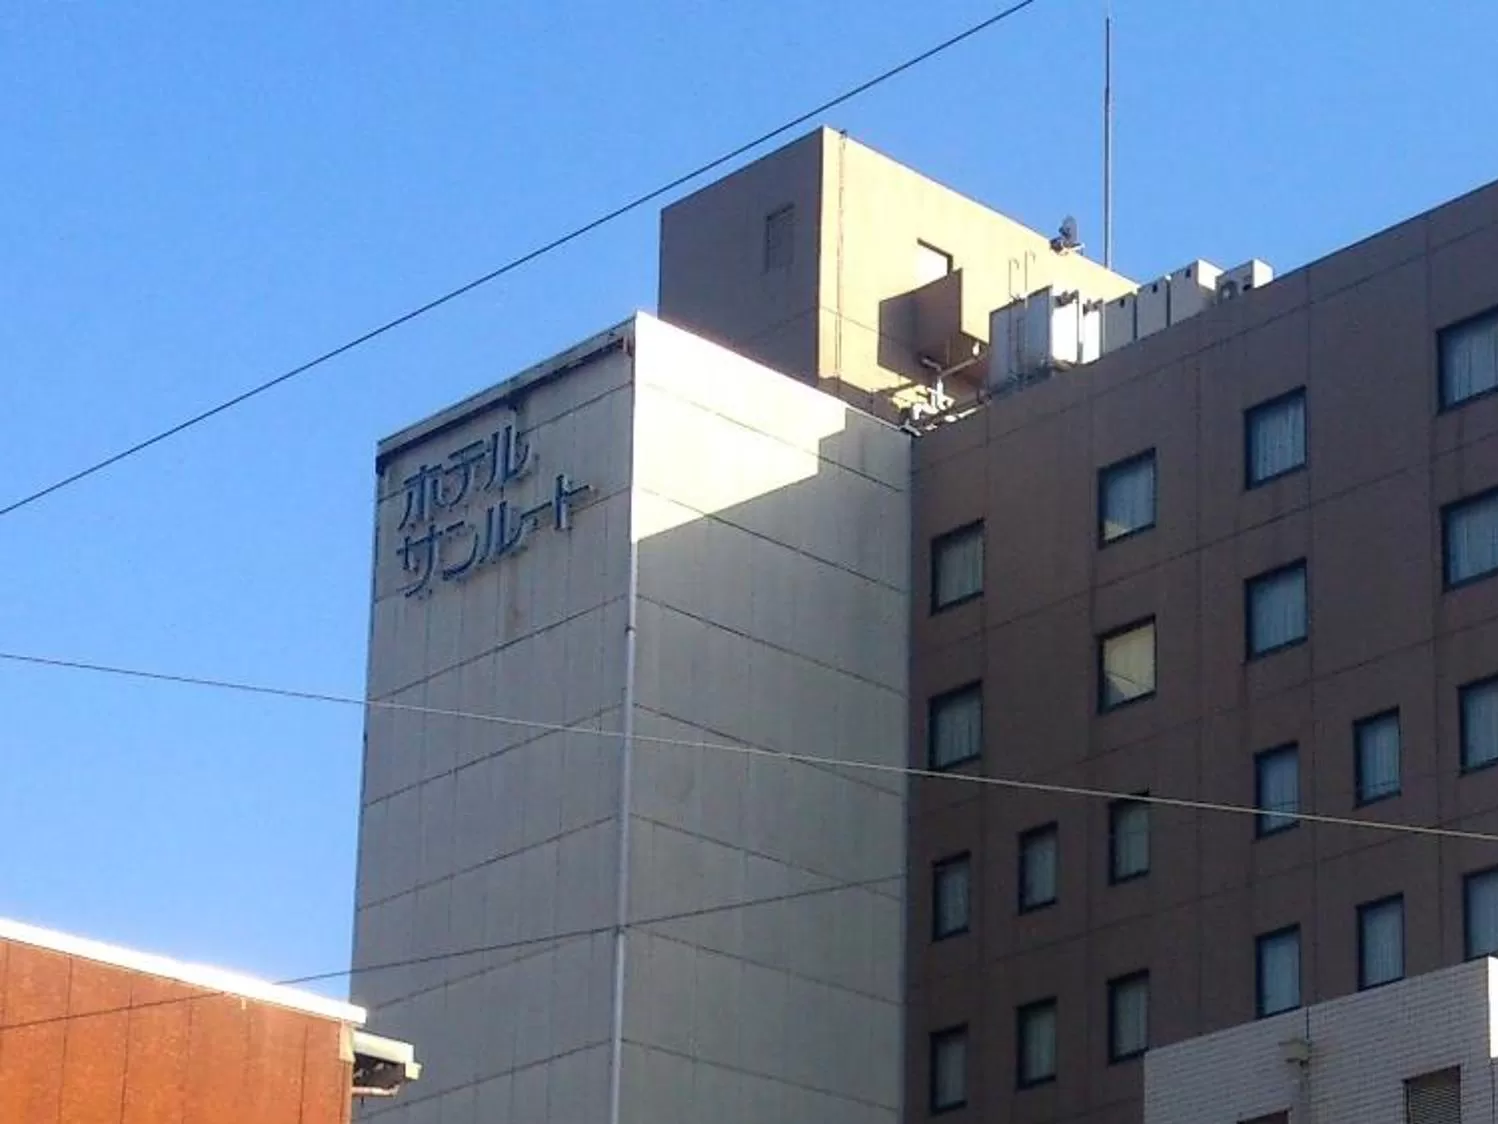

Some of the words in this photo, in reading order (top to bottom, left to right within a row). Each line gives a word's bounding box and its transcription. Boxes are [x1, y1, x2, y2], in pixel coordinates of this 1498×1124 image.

[396, 473, 592, 597] サンルート
[397, 424, 531, 531] ホテル
